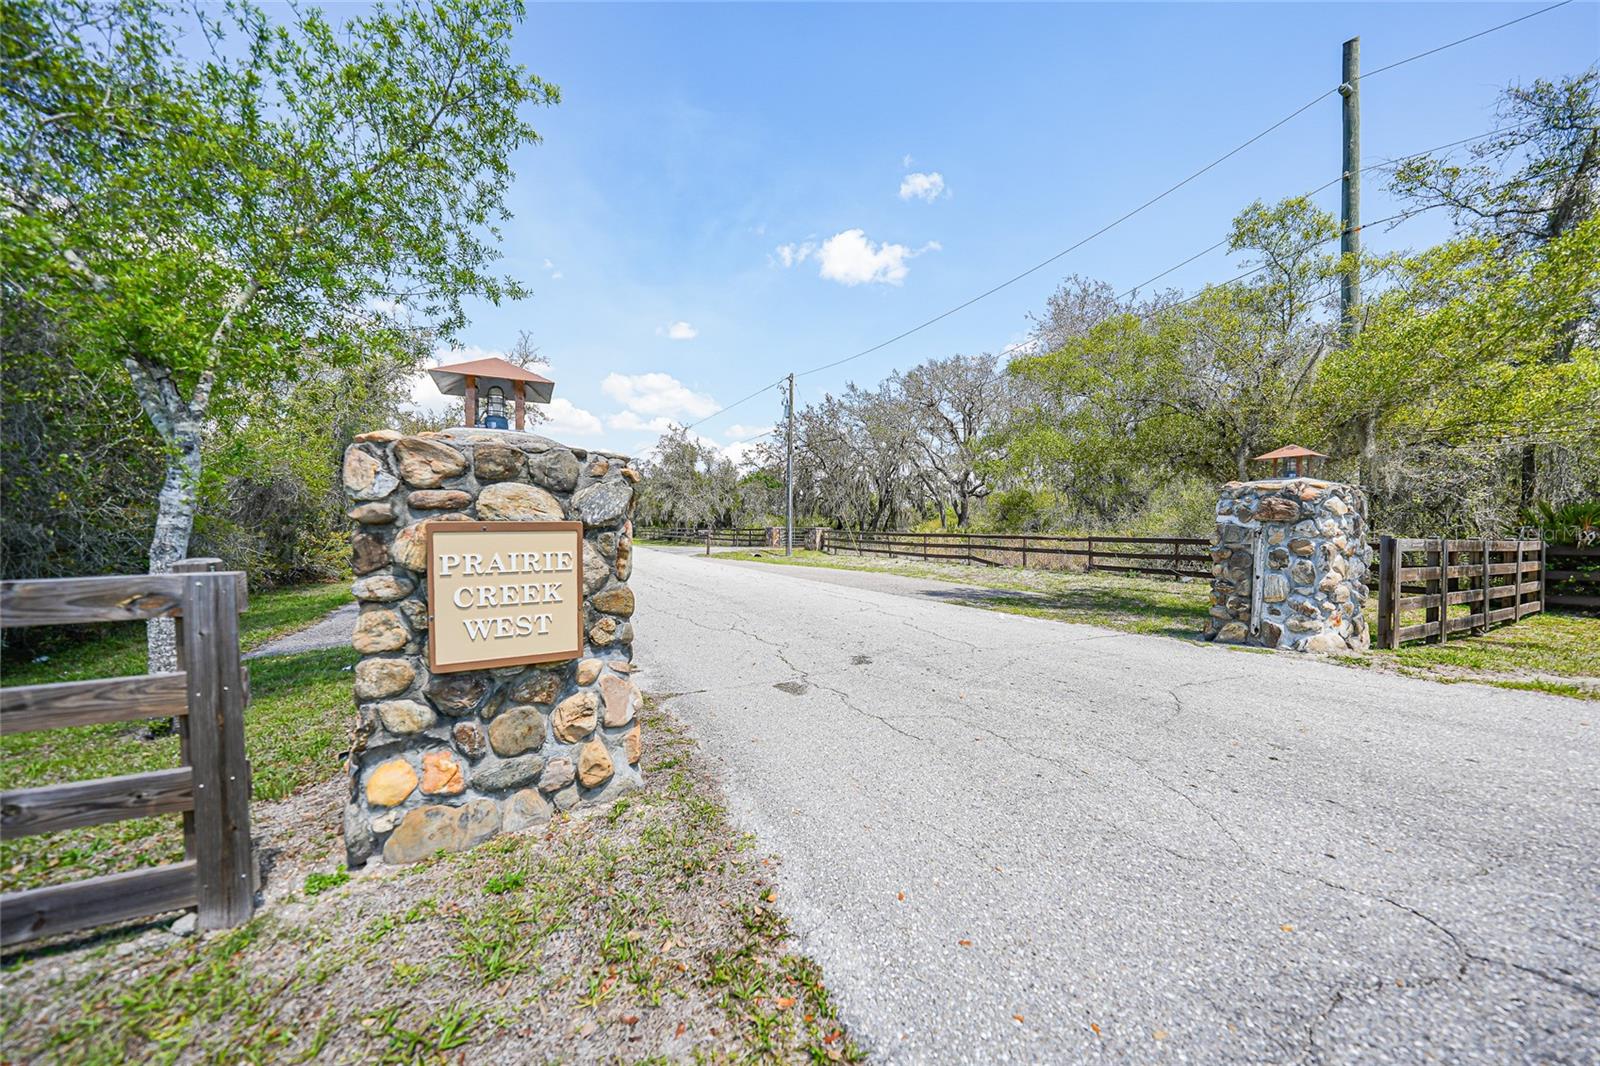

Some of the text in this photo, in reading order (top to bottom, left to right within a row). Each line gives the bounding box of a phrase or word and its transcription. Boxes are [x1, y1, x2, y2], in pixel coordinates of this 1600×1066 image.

[439, 551, 573, 577] PRAIRIE
[453, 583, 563, 609] CREEK
[463, 614, 552, 642] WEST
